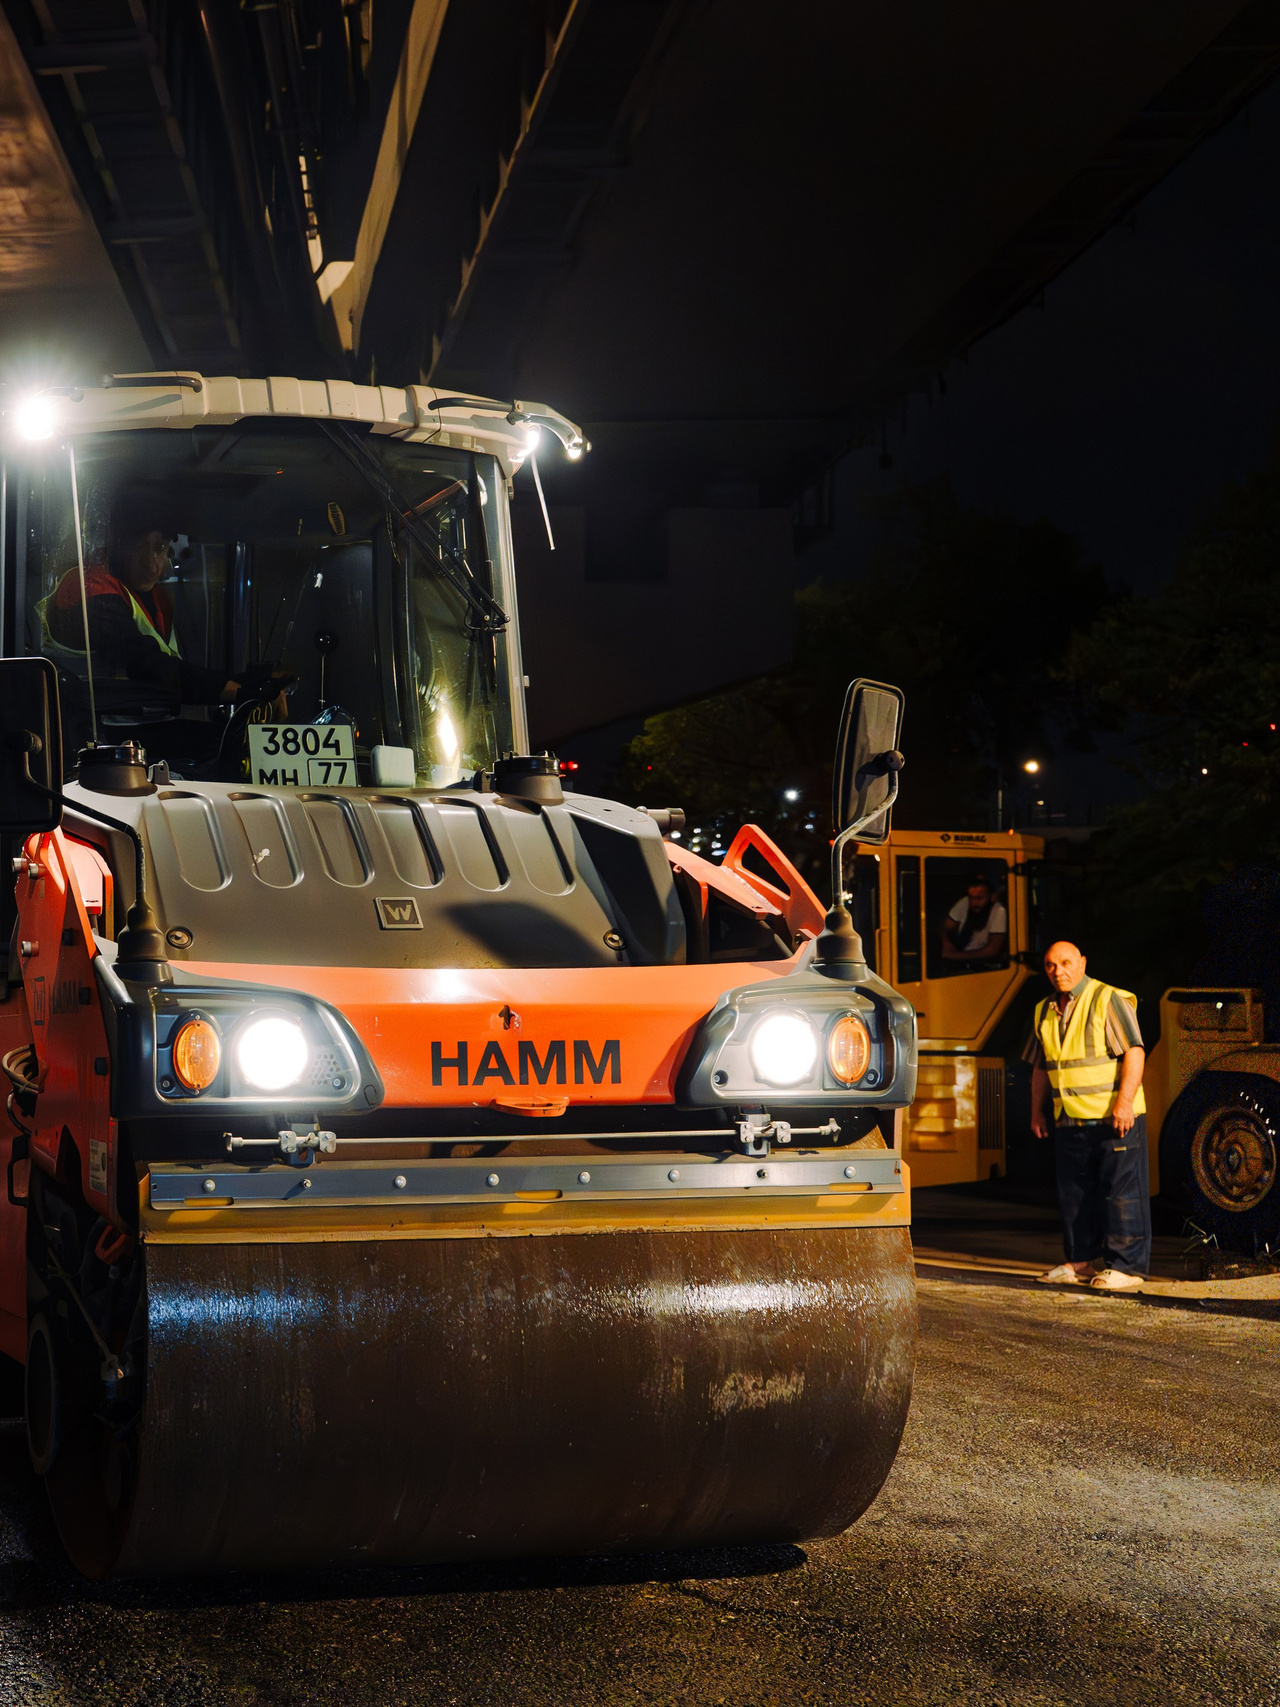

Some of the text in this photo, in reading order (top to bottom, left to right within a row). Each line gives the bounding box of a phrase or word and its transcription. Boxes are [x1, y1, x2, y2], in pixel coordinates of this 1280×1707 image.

[261, 727, 341, 756] 3804
[318, 762, 347, 784] 77
[431, 1040, 622, 1086] HAMM
